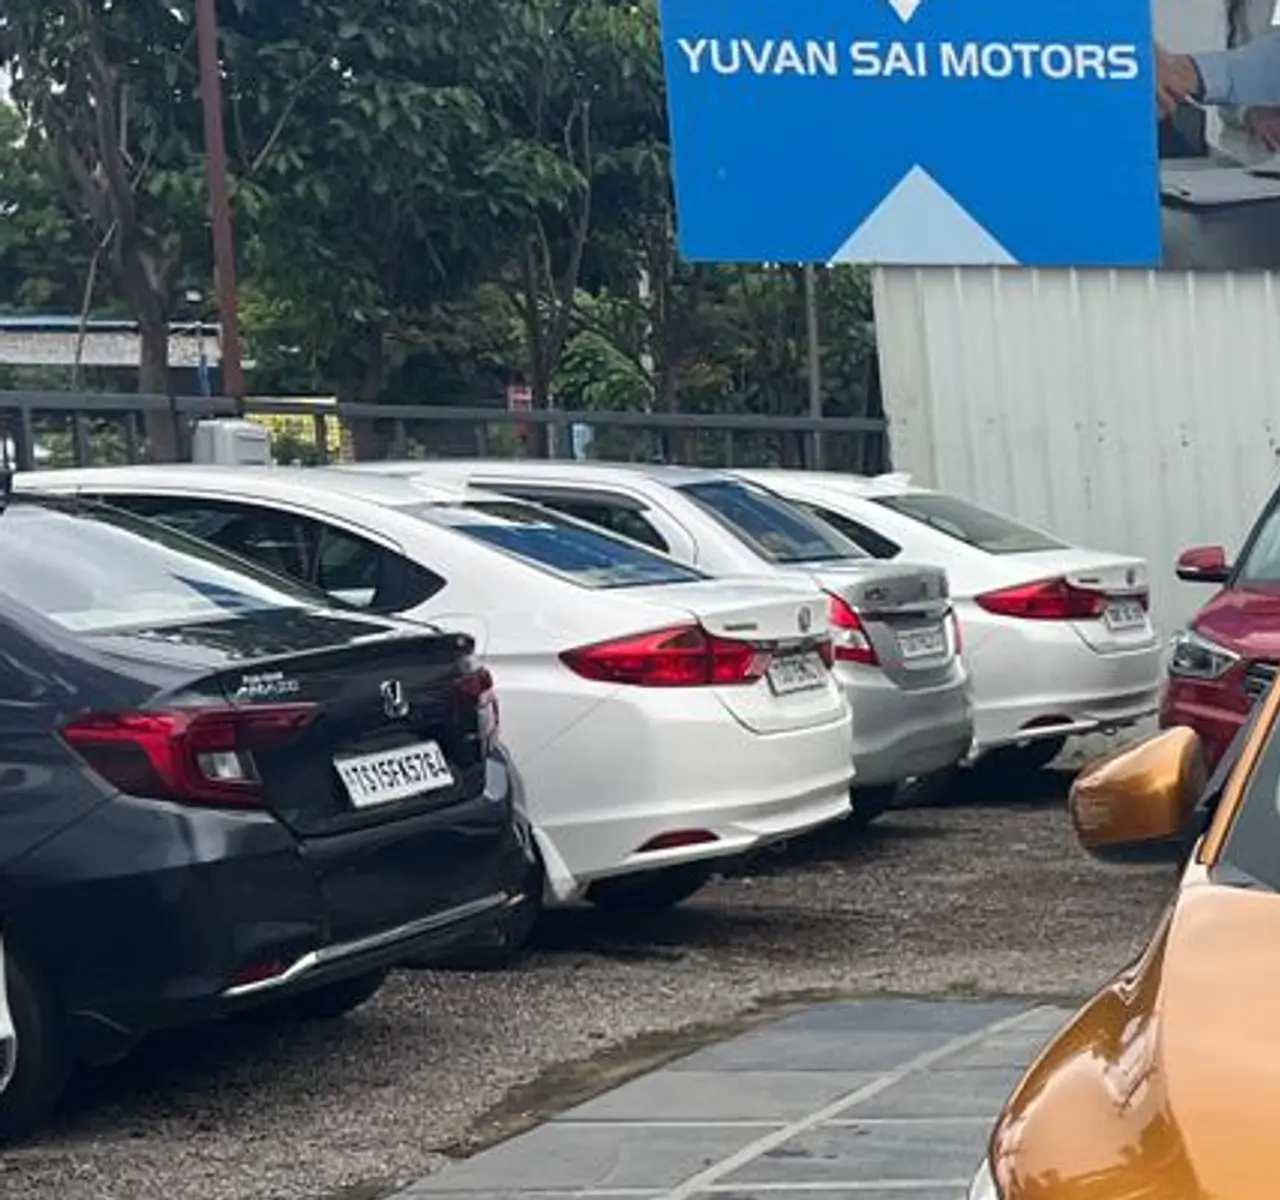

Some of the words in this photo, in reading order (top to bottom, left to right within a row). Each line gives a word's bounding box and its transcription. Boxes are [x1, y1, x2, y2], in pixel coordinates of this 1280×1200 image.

[678, 38, 838, 76] YUVAN
[851, 41, 928, 77] SAI
[940, 43, 1140, 81] MOTORS
